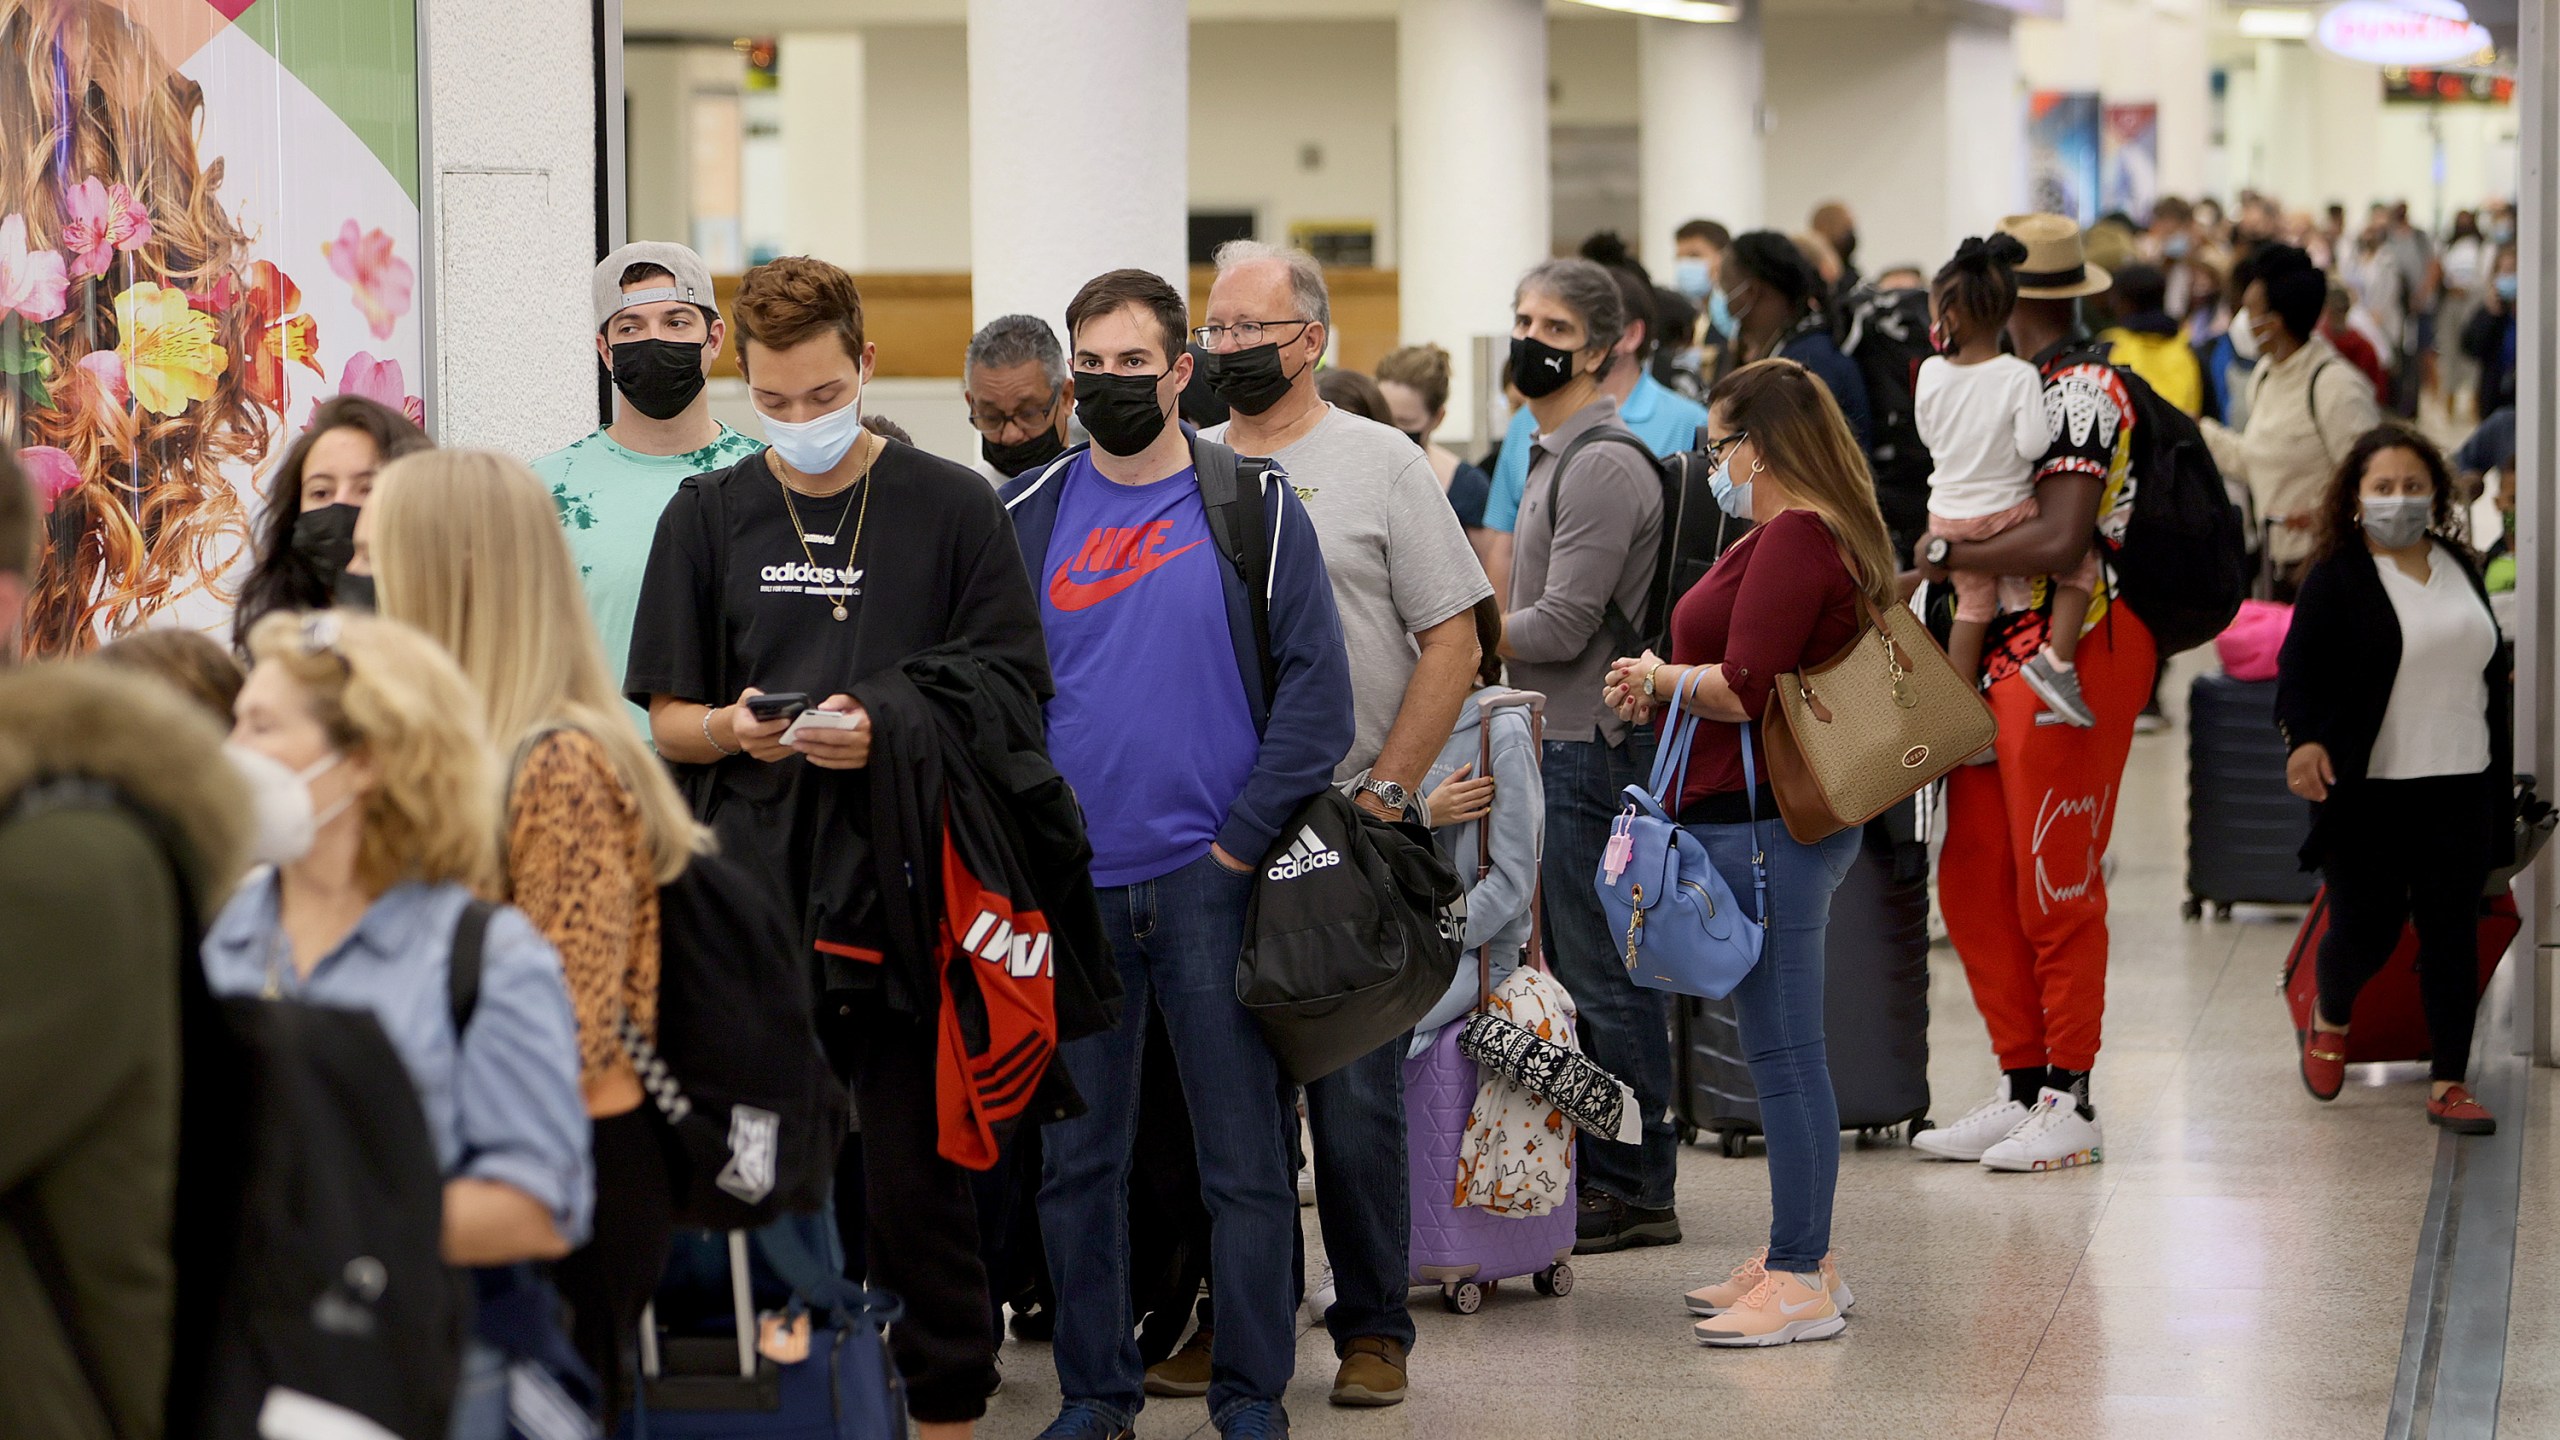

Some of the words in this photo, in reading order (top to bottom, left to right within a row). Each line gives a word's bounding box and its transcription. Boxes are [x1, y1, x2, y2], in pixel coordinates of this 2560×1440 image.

[1071, 519, 1174, 572] NIKE
[760, 561, 836, 584] adidas
[1267, 849, 1341, 881] adidas
